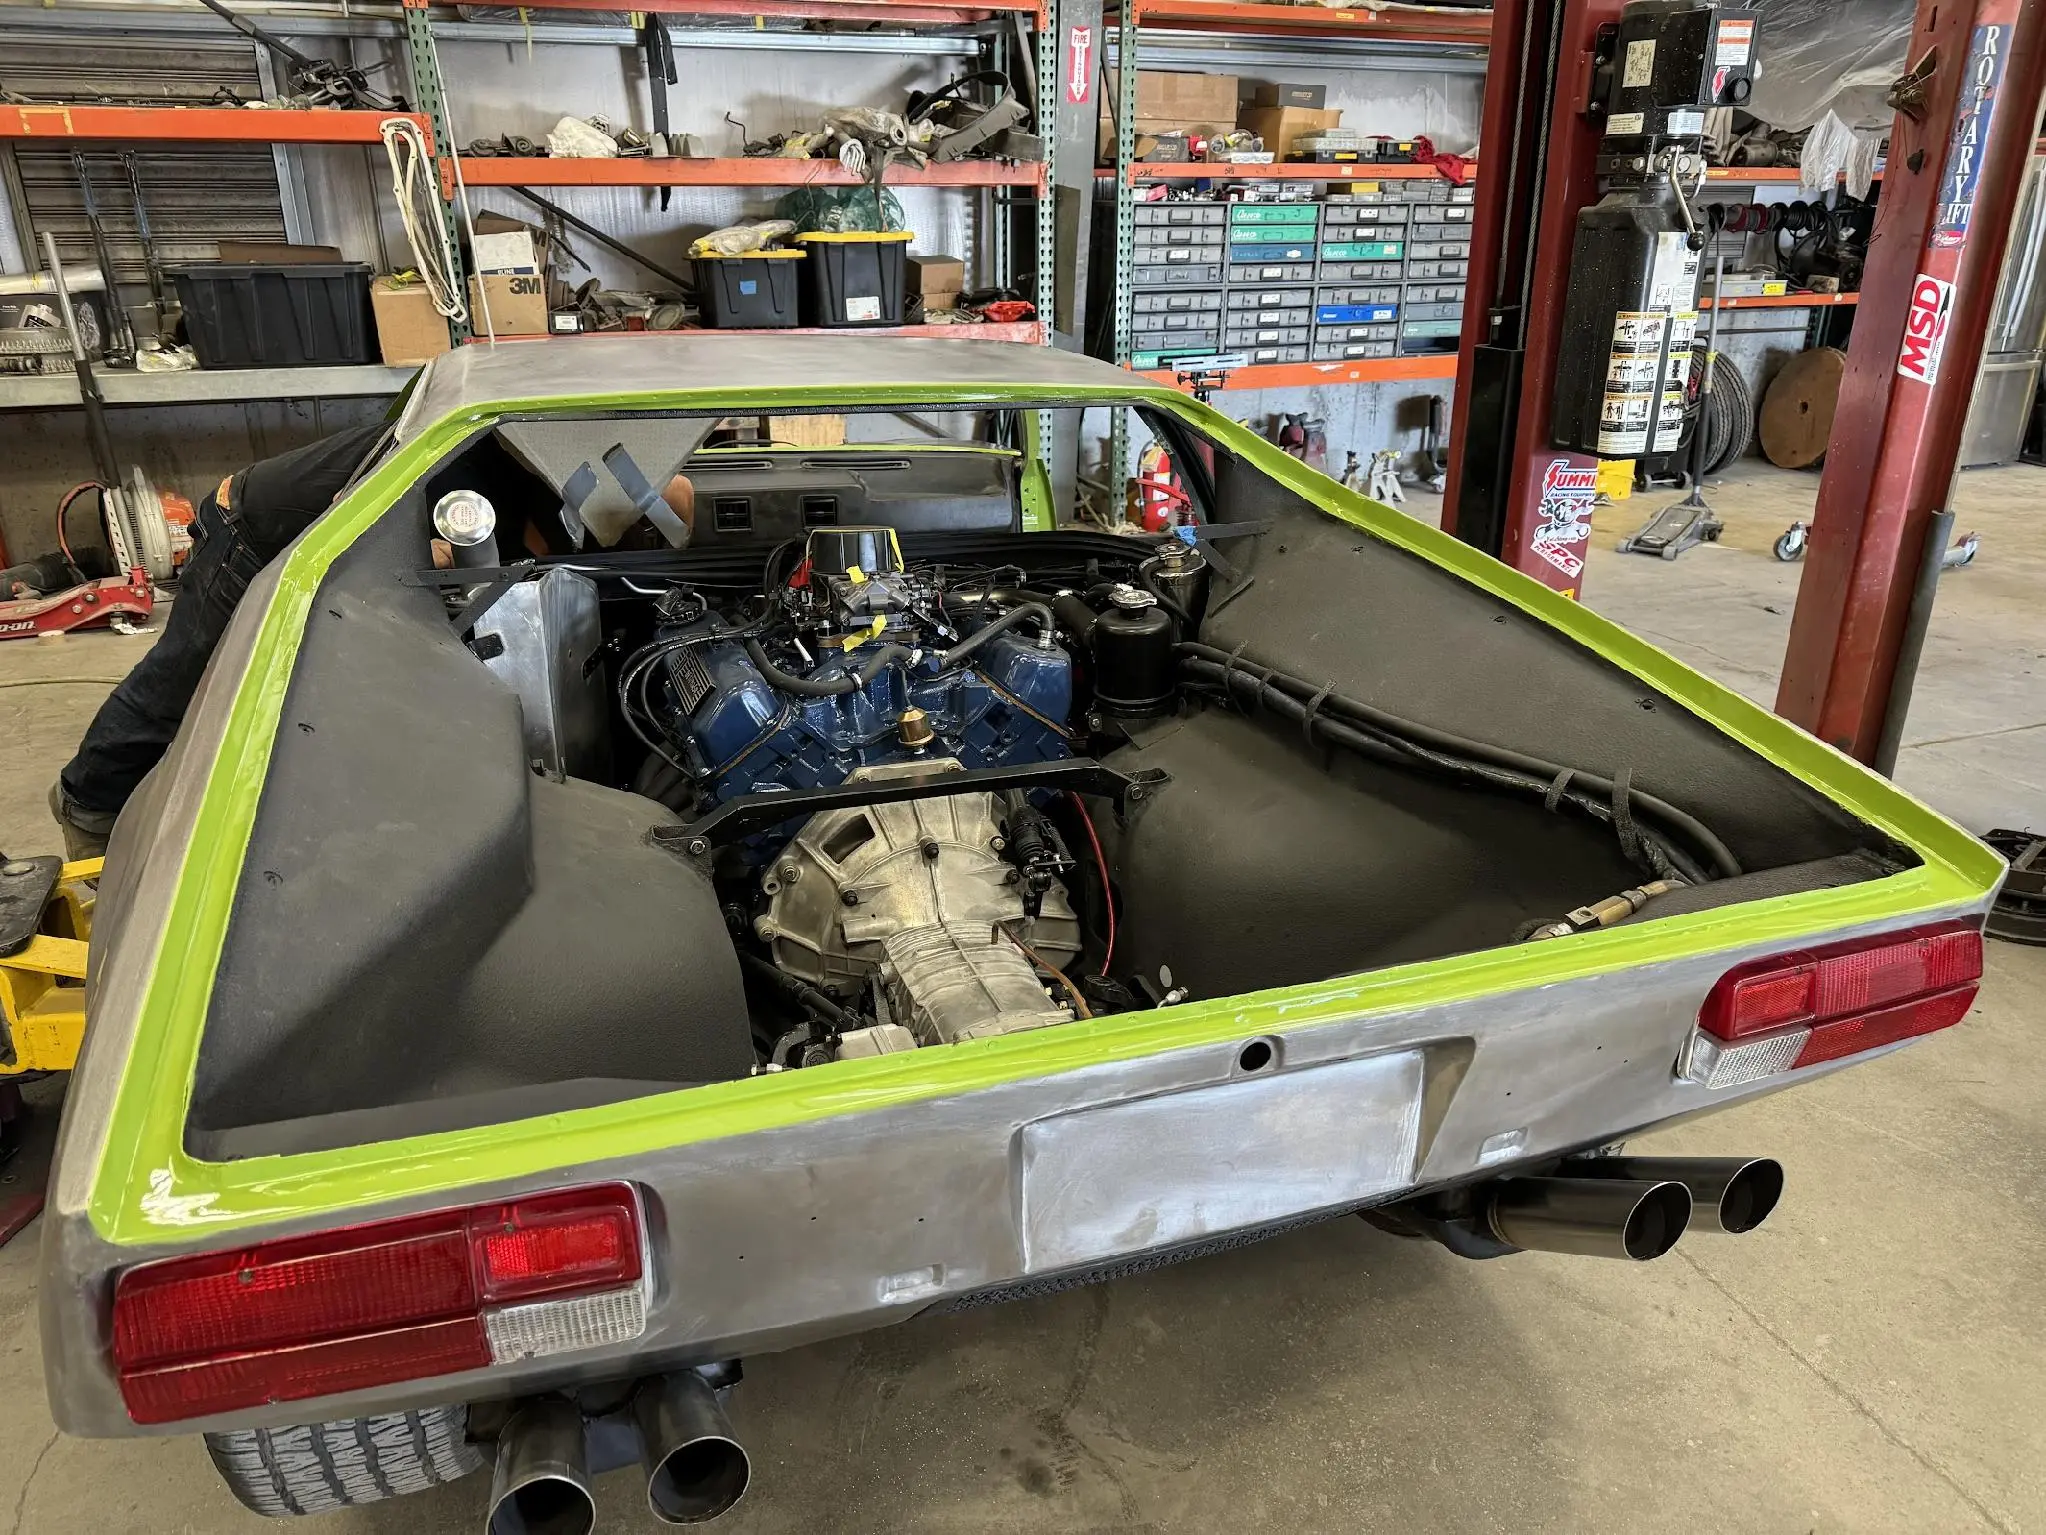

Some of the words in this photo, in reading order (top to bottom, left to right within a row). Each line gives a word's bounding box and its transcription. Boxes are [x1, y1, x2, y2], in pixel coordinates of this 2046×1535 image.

[1074, 34, 1088, 44] FIRE
[1953, 26, 2000, 203] ROTARY
[509, 277, 541, 295] 3M
[1900, 280, 1940, 376] MSD
[1547, 464, 1596, 491] SUMMI
[1539, 542, 1580, 568] SPC
